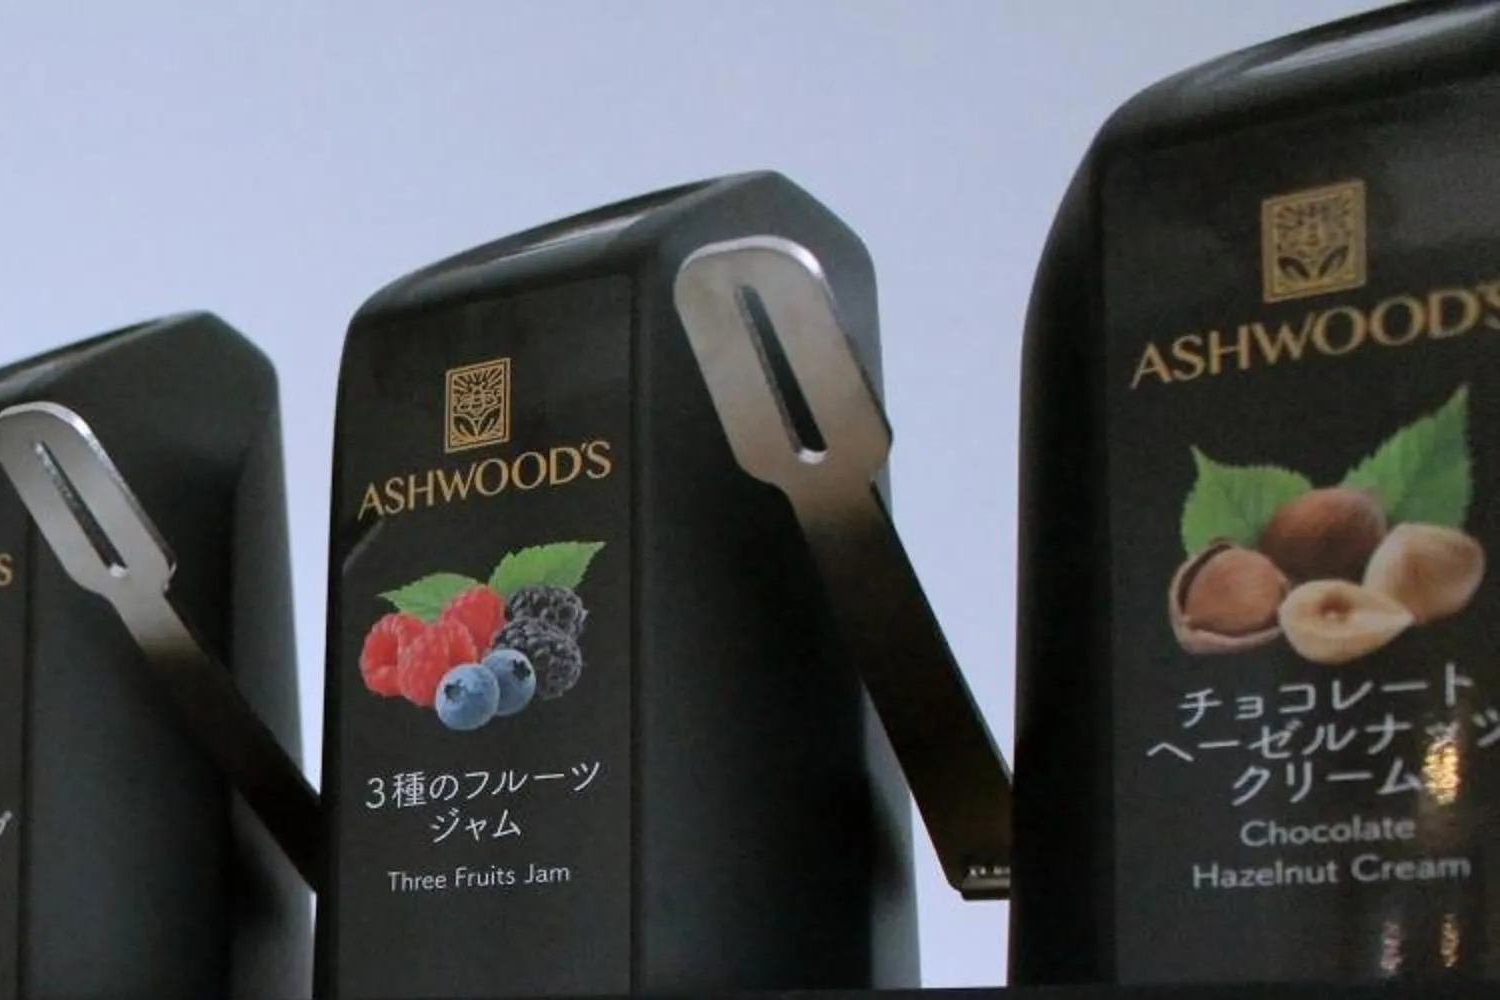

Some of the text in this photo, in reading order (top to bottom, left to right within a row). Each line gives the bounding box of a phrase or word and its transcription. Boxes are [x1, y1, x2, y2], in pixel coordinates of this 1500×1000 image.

[357, 440, 612, 522] ASHWOOD'S
[1178, 662, 1473, 728] チョコレート
[1231, 757, 1422, 806] クリーム
[430, 808, 522, 843] ジャム
[1240, 815, 1416, 847] Chocolate
[387, 863, 570, 892] Three Fruits Jam
[1192, 853, 1472, 890] Hazelnut Cream
